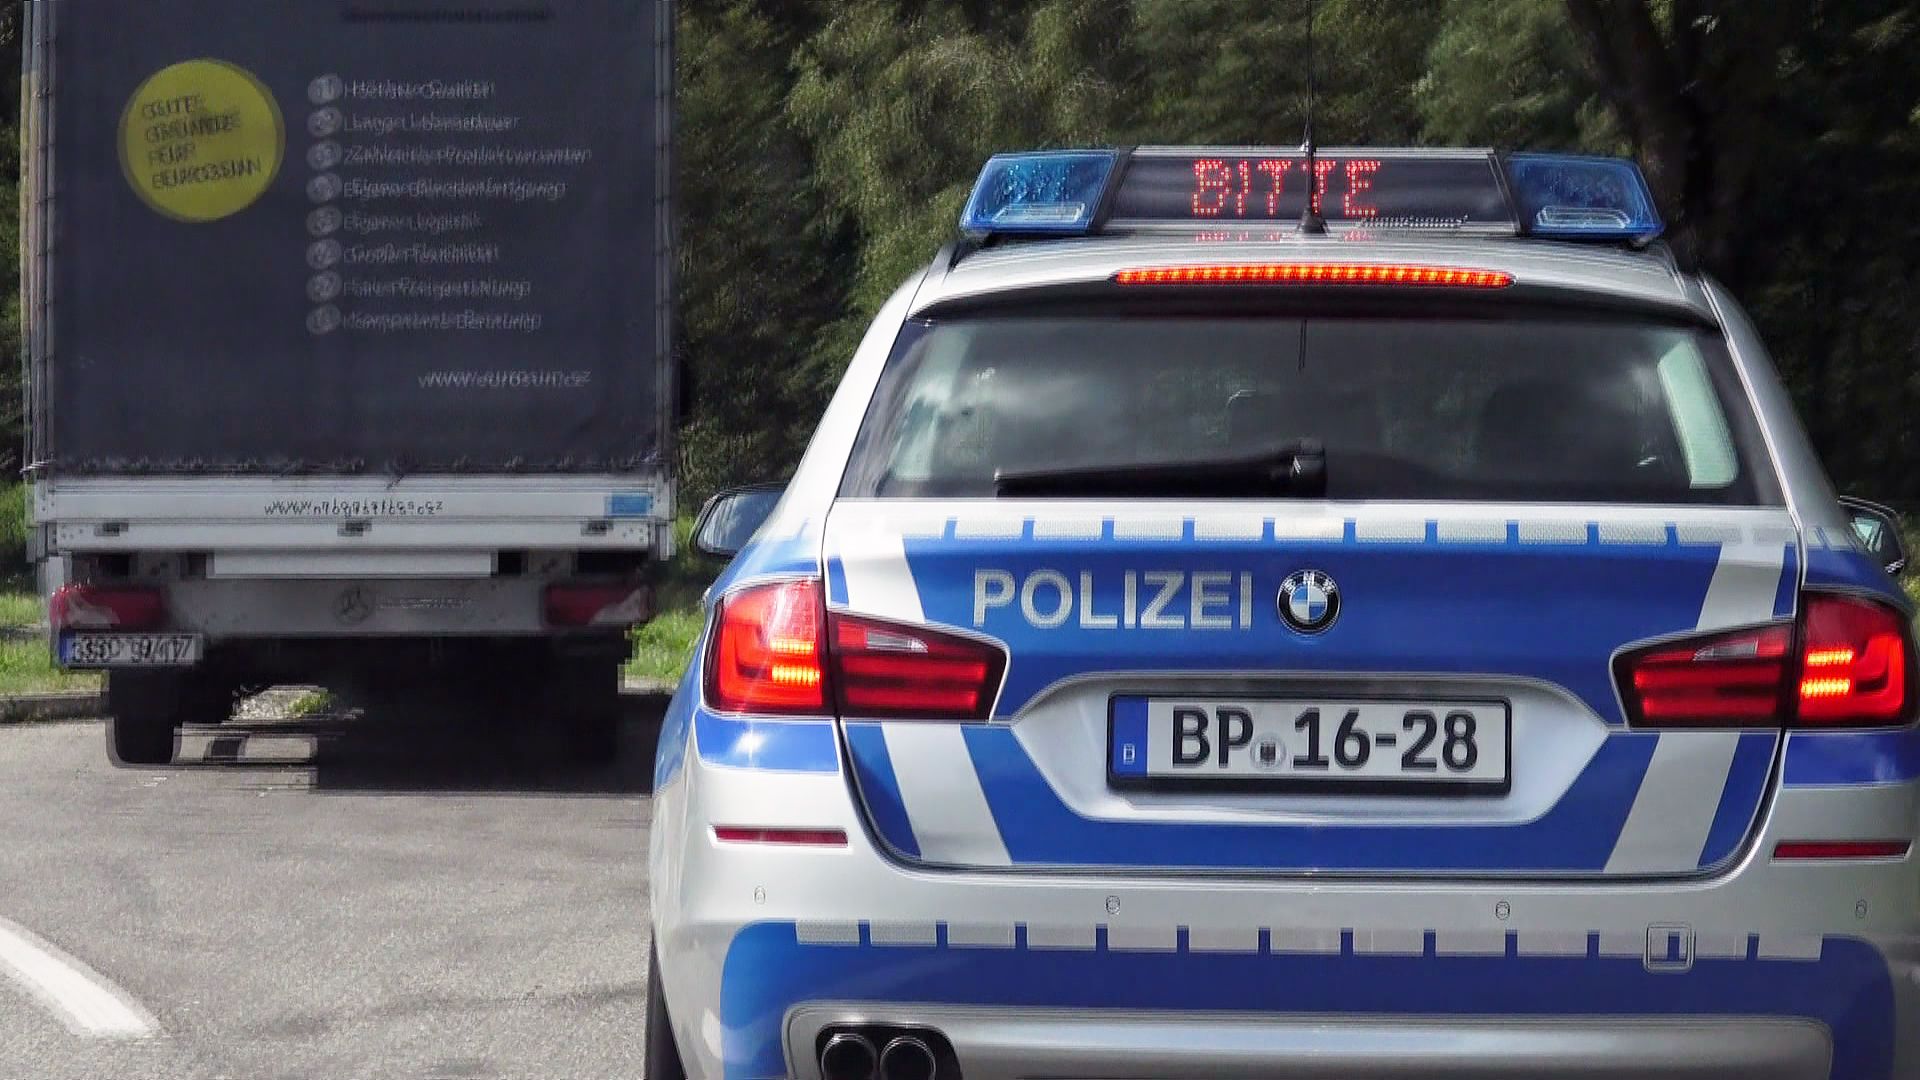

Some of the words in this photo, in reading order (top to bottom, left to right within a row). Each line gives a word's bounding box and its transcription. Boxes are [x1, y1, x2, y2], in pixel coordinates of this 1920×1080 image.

[1193, 159, 1381, 217] BITTE
[973, 569, 1252, 629] POLIZEI
[1280, 570, 1337, 595] BMW
[1172, 705, 1254, 769] BP
[1292, 707, 1479, 771] 16-28
